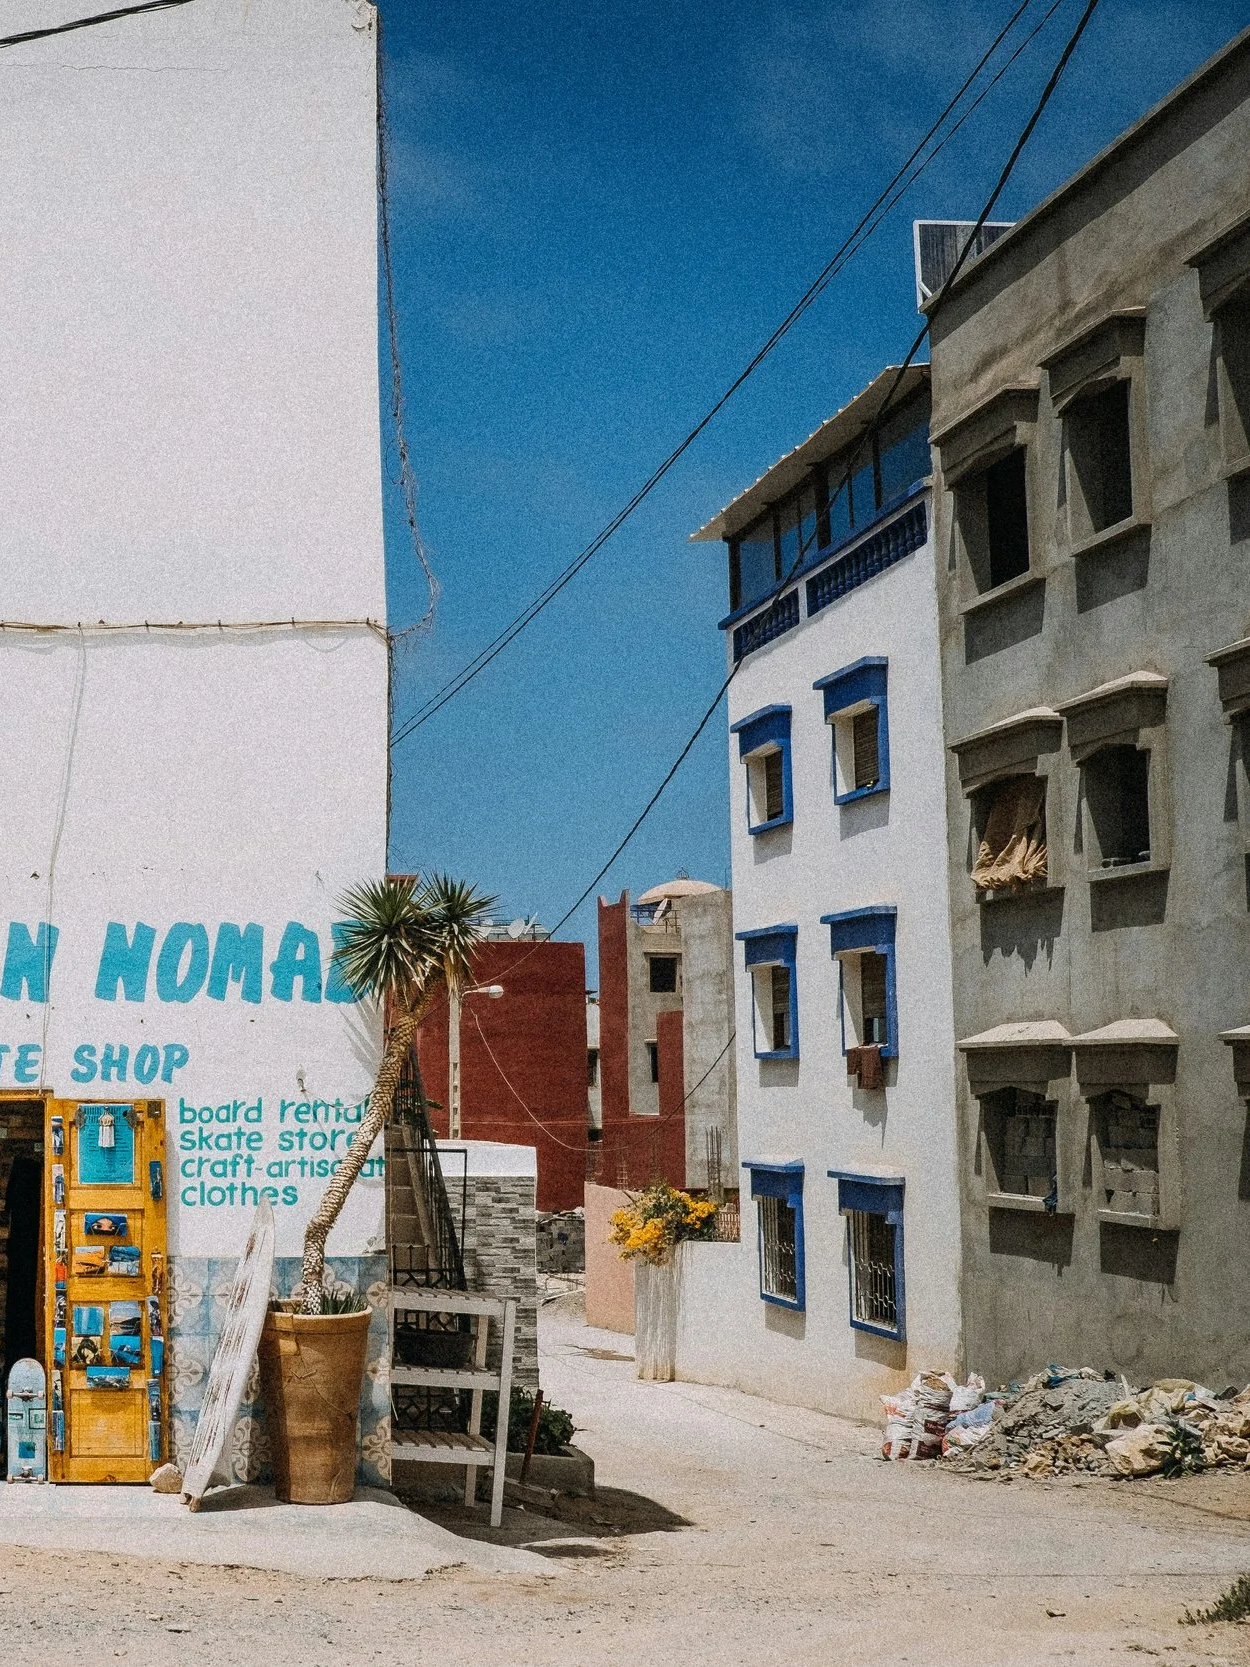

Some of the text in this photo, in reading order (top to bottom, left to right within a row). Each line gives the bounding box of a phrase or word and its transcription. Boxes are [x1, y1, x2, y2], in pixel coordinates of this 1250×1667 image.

[70, 1043, 190, 1084] SHOP
[179, 1097, 263, 1124] board
[180, 1126, 263, 1151] skate
[180, 1154, 386, 1178] craft-artisat
[180, 1181, 299, 1207] clothes
